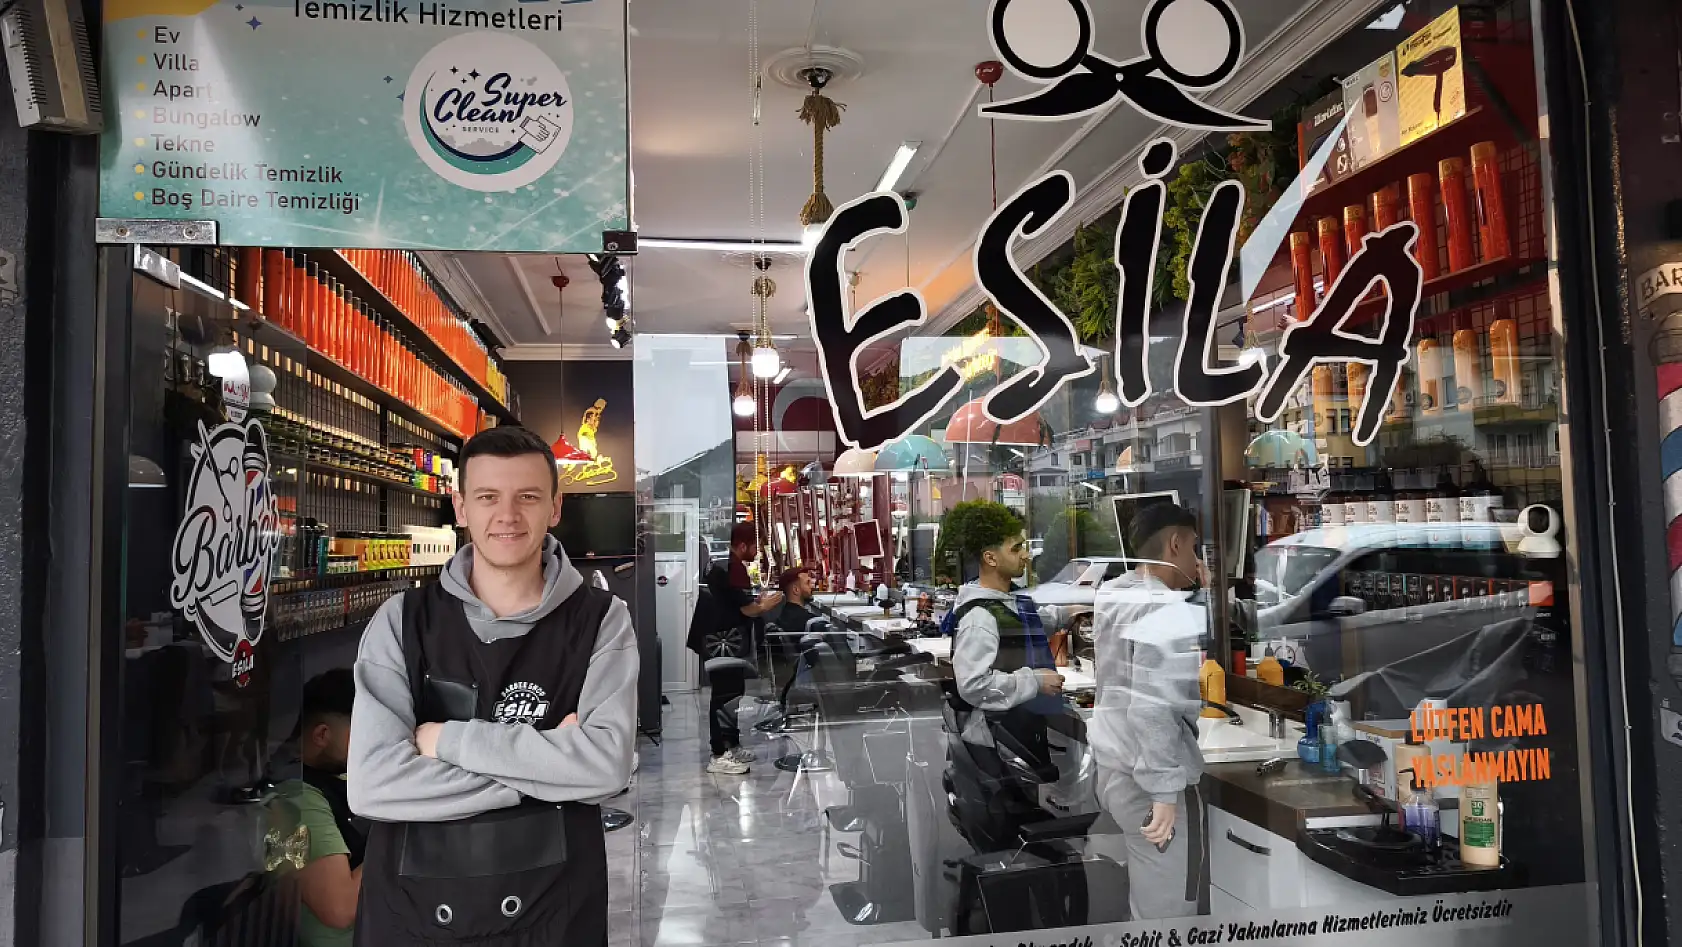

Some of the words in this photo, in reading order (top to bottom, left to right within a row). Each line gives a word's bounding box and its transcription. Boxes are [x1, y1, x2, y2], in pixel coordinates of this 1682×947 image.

[419, 2, 563, 31] Hizmetleri
[154, 26, 181, 44] Ev
[153, 53, 200, 71] Villa
[153, 79, 213, 101] Apart
[481, 72, 567, 118] Super
[152, 106, 261, 129] Bungalow
[433, 87, 518, 123] Clean
[150, 134, 215, 152] Tekne
[462, 126, 500, 134] SERVICE
[151, 160, 248, 180] Gündelik
[254, 163, 343, 183] Temizlik
[151, 188, 193, 210] Boş
[200, 189, 259, 208] Daire
[265, 191, 360, 214] Temizliği
[805, 137, 1424, 452] ESİLA
[173, 488, 280, 603] Barber
[1410, 702, 1485, 742] LÜTFEN
[1490, 703, 1548, 738] CAMA
[1411, 748, 1551, 788] YASLANMAYIN
[1167, 928, 1182, 947] &
[1186, 923, 1224, 945] Gazi
[1227, 919, 1317, 942] Yakınlarına
[1322, 908, 1428, 934] Hizmetlerimiz
[1431, 900, 1513, 922] Ücretsizdir
